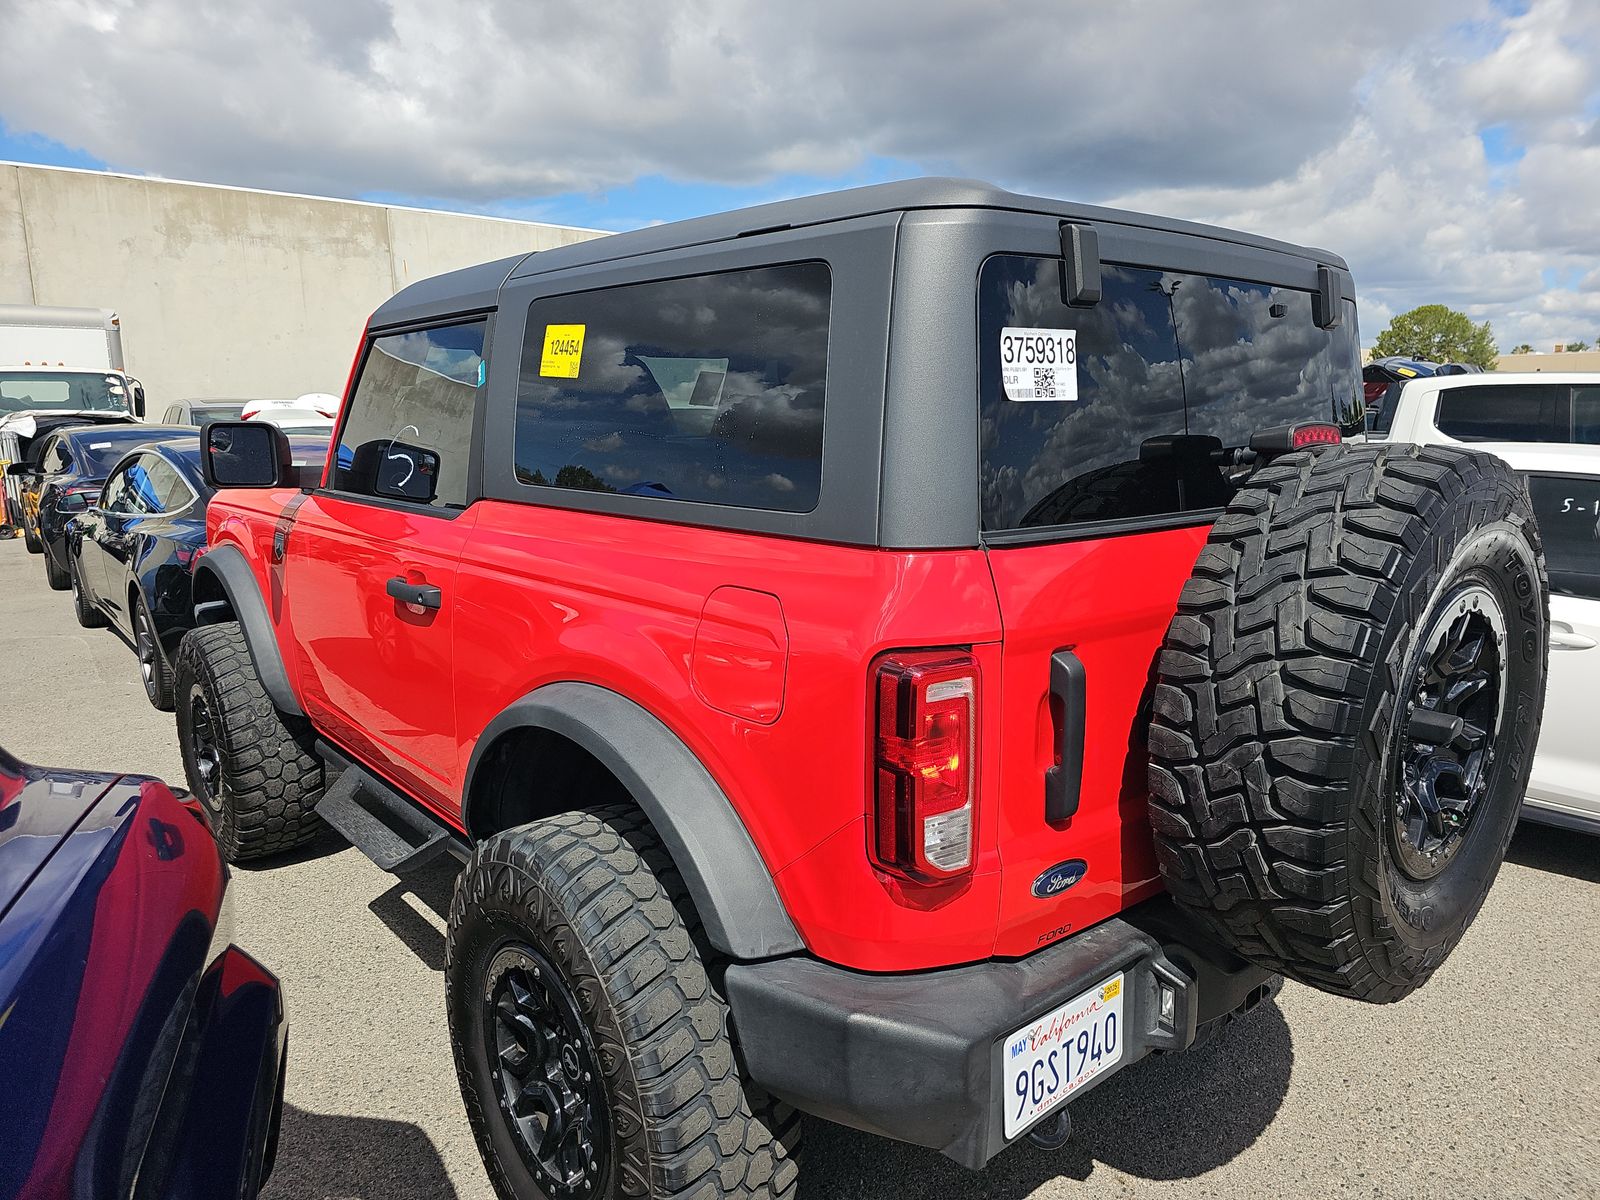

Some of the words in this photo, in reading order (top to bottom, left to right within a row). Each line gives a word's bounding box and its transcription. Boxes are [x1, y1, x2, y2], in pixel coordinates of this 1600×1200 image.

[551, 339, 580, 355] 124454
[1003, 336, 1075, 364] 3759318
[1003, 375, 1018, 384] DLR
[1505, 549, 1537, 663] TOYO
[1047, 870, 1077, 893] Ford
[1037, 923, 1072, 944] FORD
[1030, 999, 1104, 1052] California
[1011, 1038, 1027, 1059] MAY
[1016, 1012, 1117, 1121] 9GST940
[1037, 1067, 1096, 1112] dmv.ca.gov
